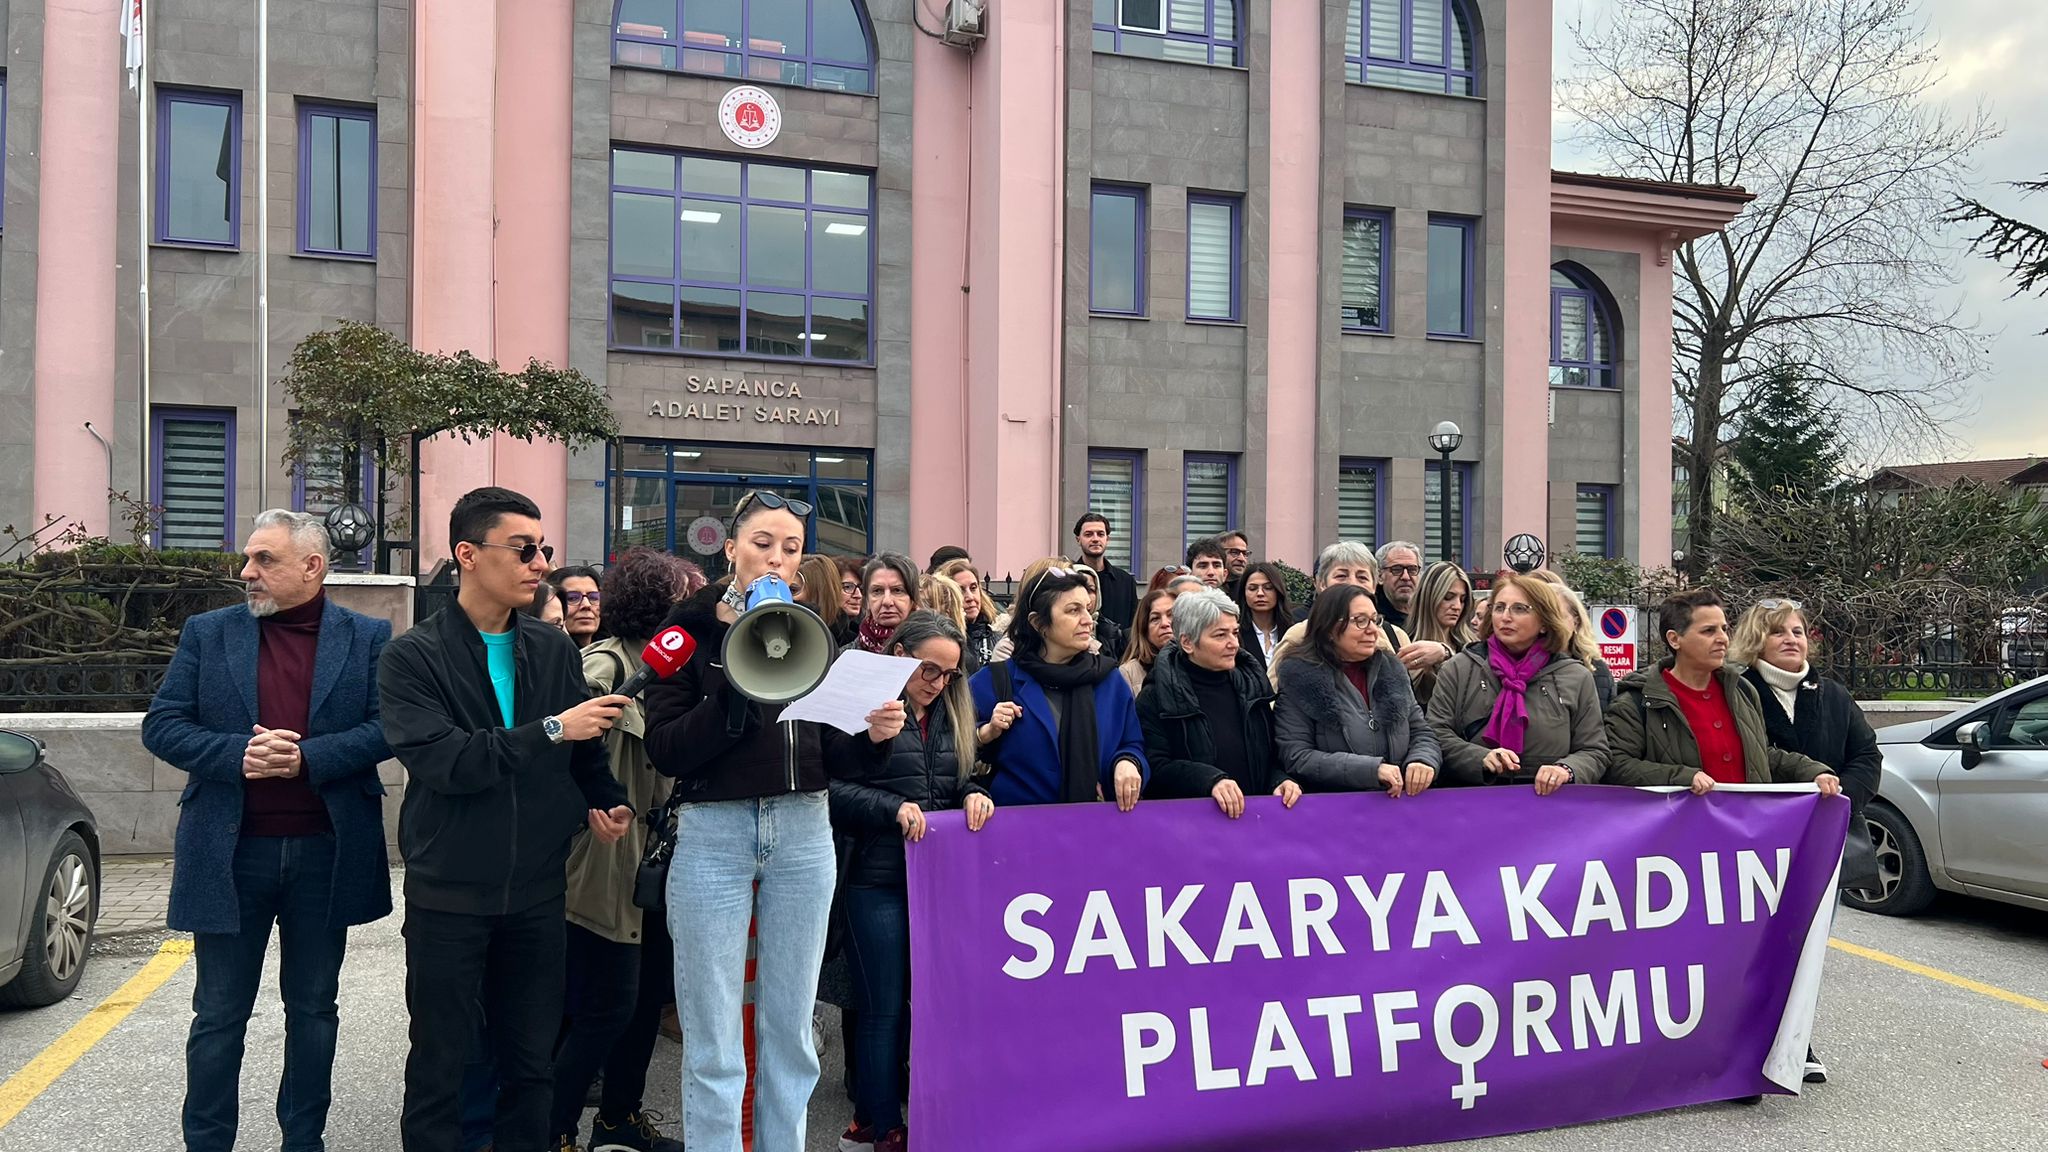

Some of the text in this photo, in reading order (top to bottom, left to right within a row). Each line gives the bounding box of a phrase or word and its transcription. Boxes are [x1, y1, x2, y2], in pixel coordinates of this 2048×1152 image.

[686, 375, 802, 398] SAPANCA
[648, 400, 840, 426] ADALET SARAYI
[1603, 644, 1624, 654] RESMİ
[1001, 847, 1791, 980] SAKARYA KADIN
[1121, 964, 1705, 1110] PLATFORMU
